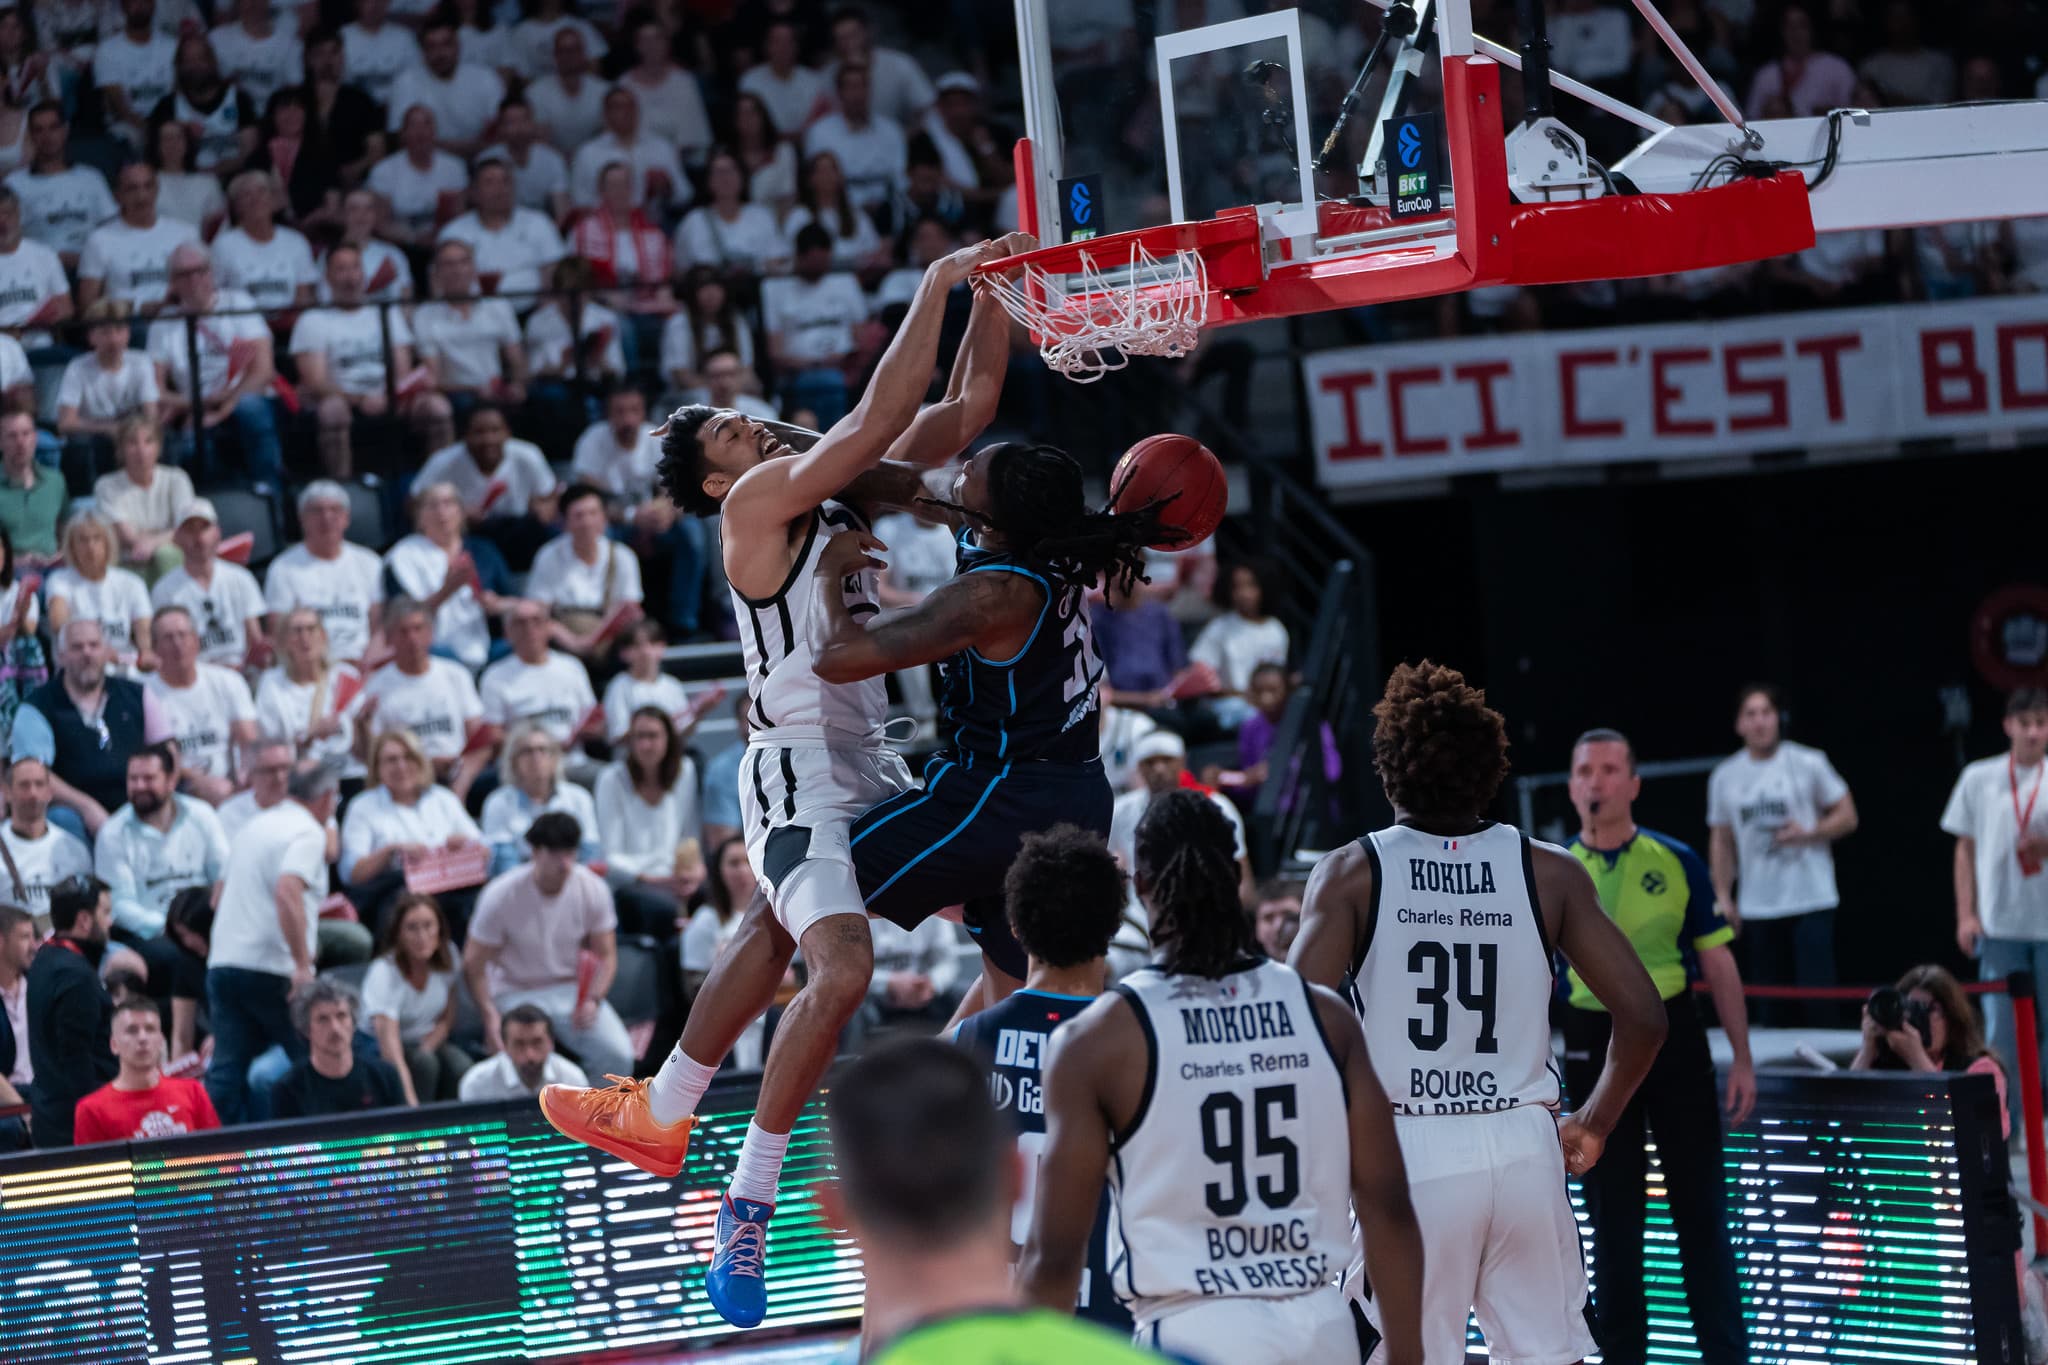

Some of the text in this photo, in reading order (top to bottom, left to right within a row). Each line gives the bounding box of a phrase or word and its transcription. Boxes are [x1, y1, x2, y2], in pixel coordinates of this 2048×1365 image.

[1399, 175, 1427, 195] BKT
[1397, 196, 1432, 213] EuroCup
[1319, 360, 1521, 463] ICI
[1558, 330, 1863, 440] C'EST
[1409, 858, 1496, 895] KOKILA
[1397, 908, 1453, 926] Charles
[1407, 940, 1498, 1054] 34
[1180, 1001, 1295, 1045] MOKOKA
[1180, 1062, 1244, 1080] Charles
[1410, 1067, 1498, 1099] BOURG
[1200, 1083, 1299, 1217] 95
[1206, 1219, 1309, 1261] BOURG
[1195, 1266, 1239, 1295] EN
